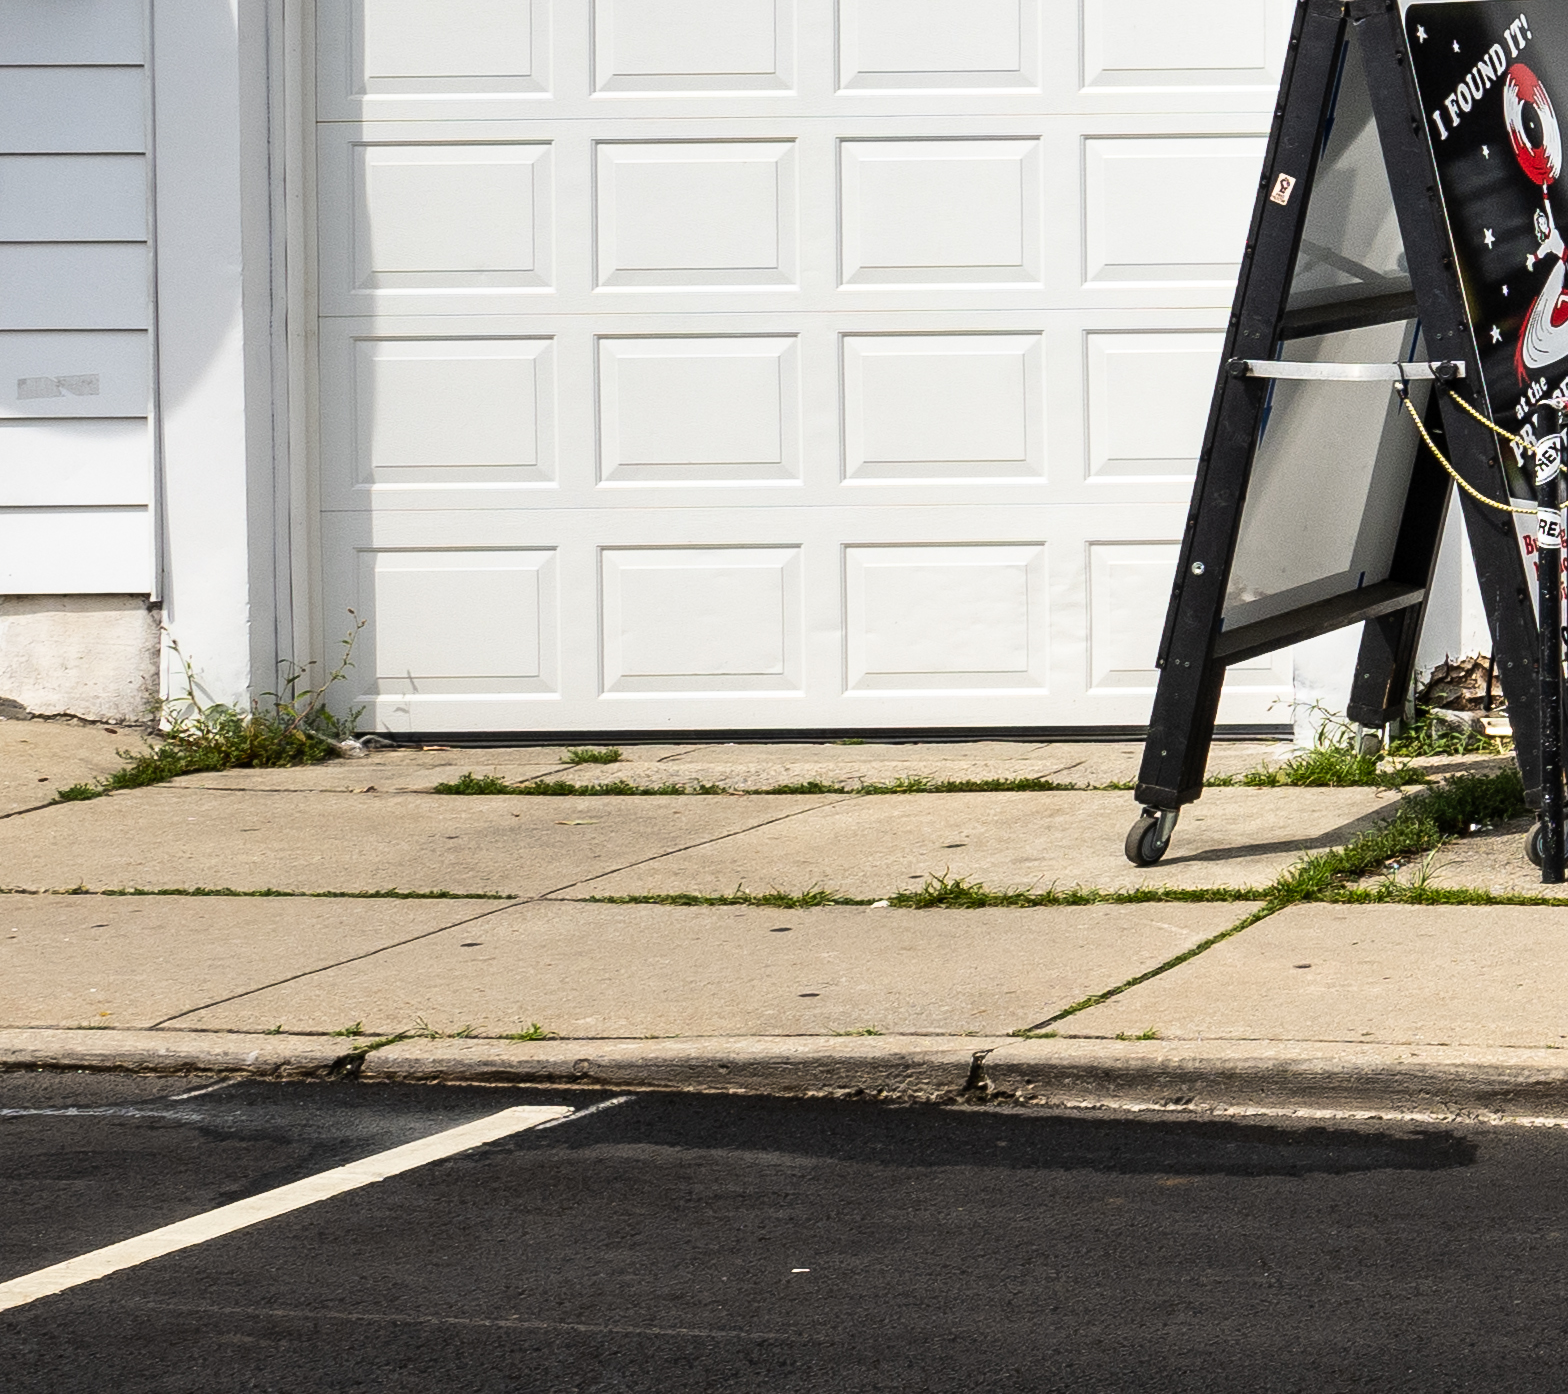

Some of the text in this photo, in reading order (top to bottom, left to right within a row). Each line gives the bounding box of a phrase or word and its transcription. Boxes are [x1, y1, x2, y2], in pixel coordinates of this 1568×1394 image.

[1432, 13, 1533, 141] I FOUND IT!
[1514, 376, 1548, 420] at the
